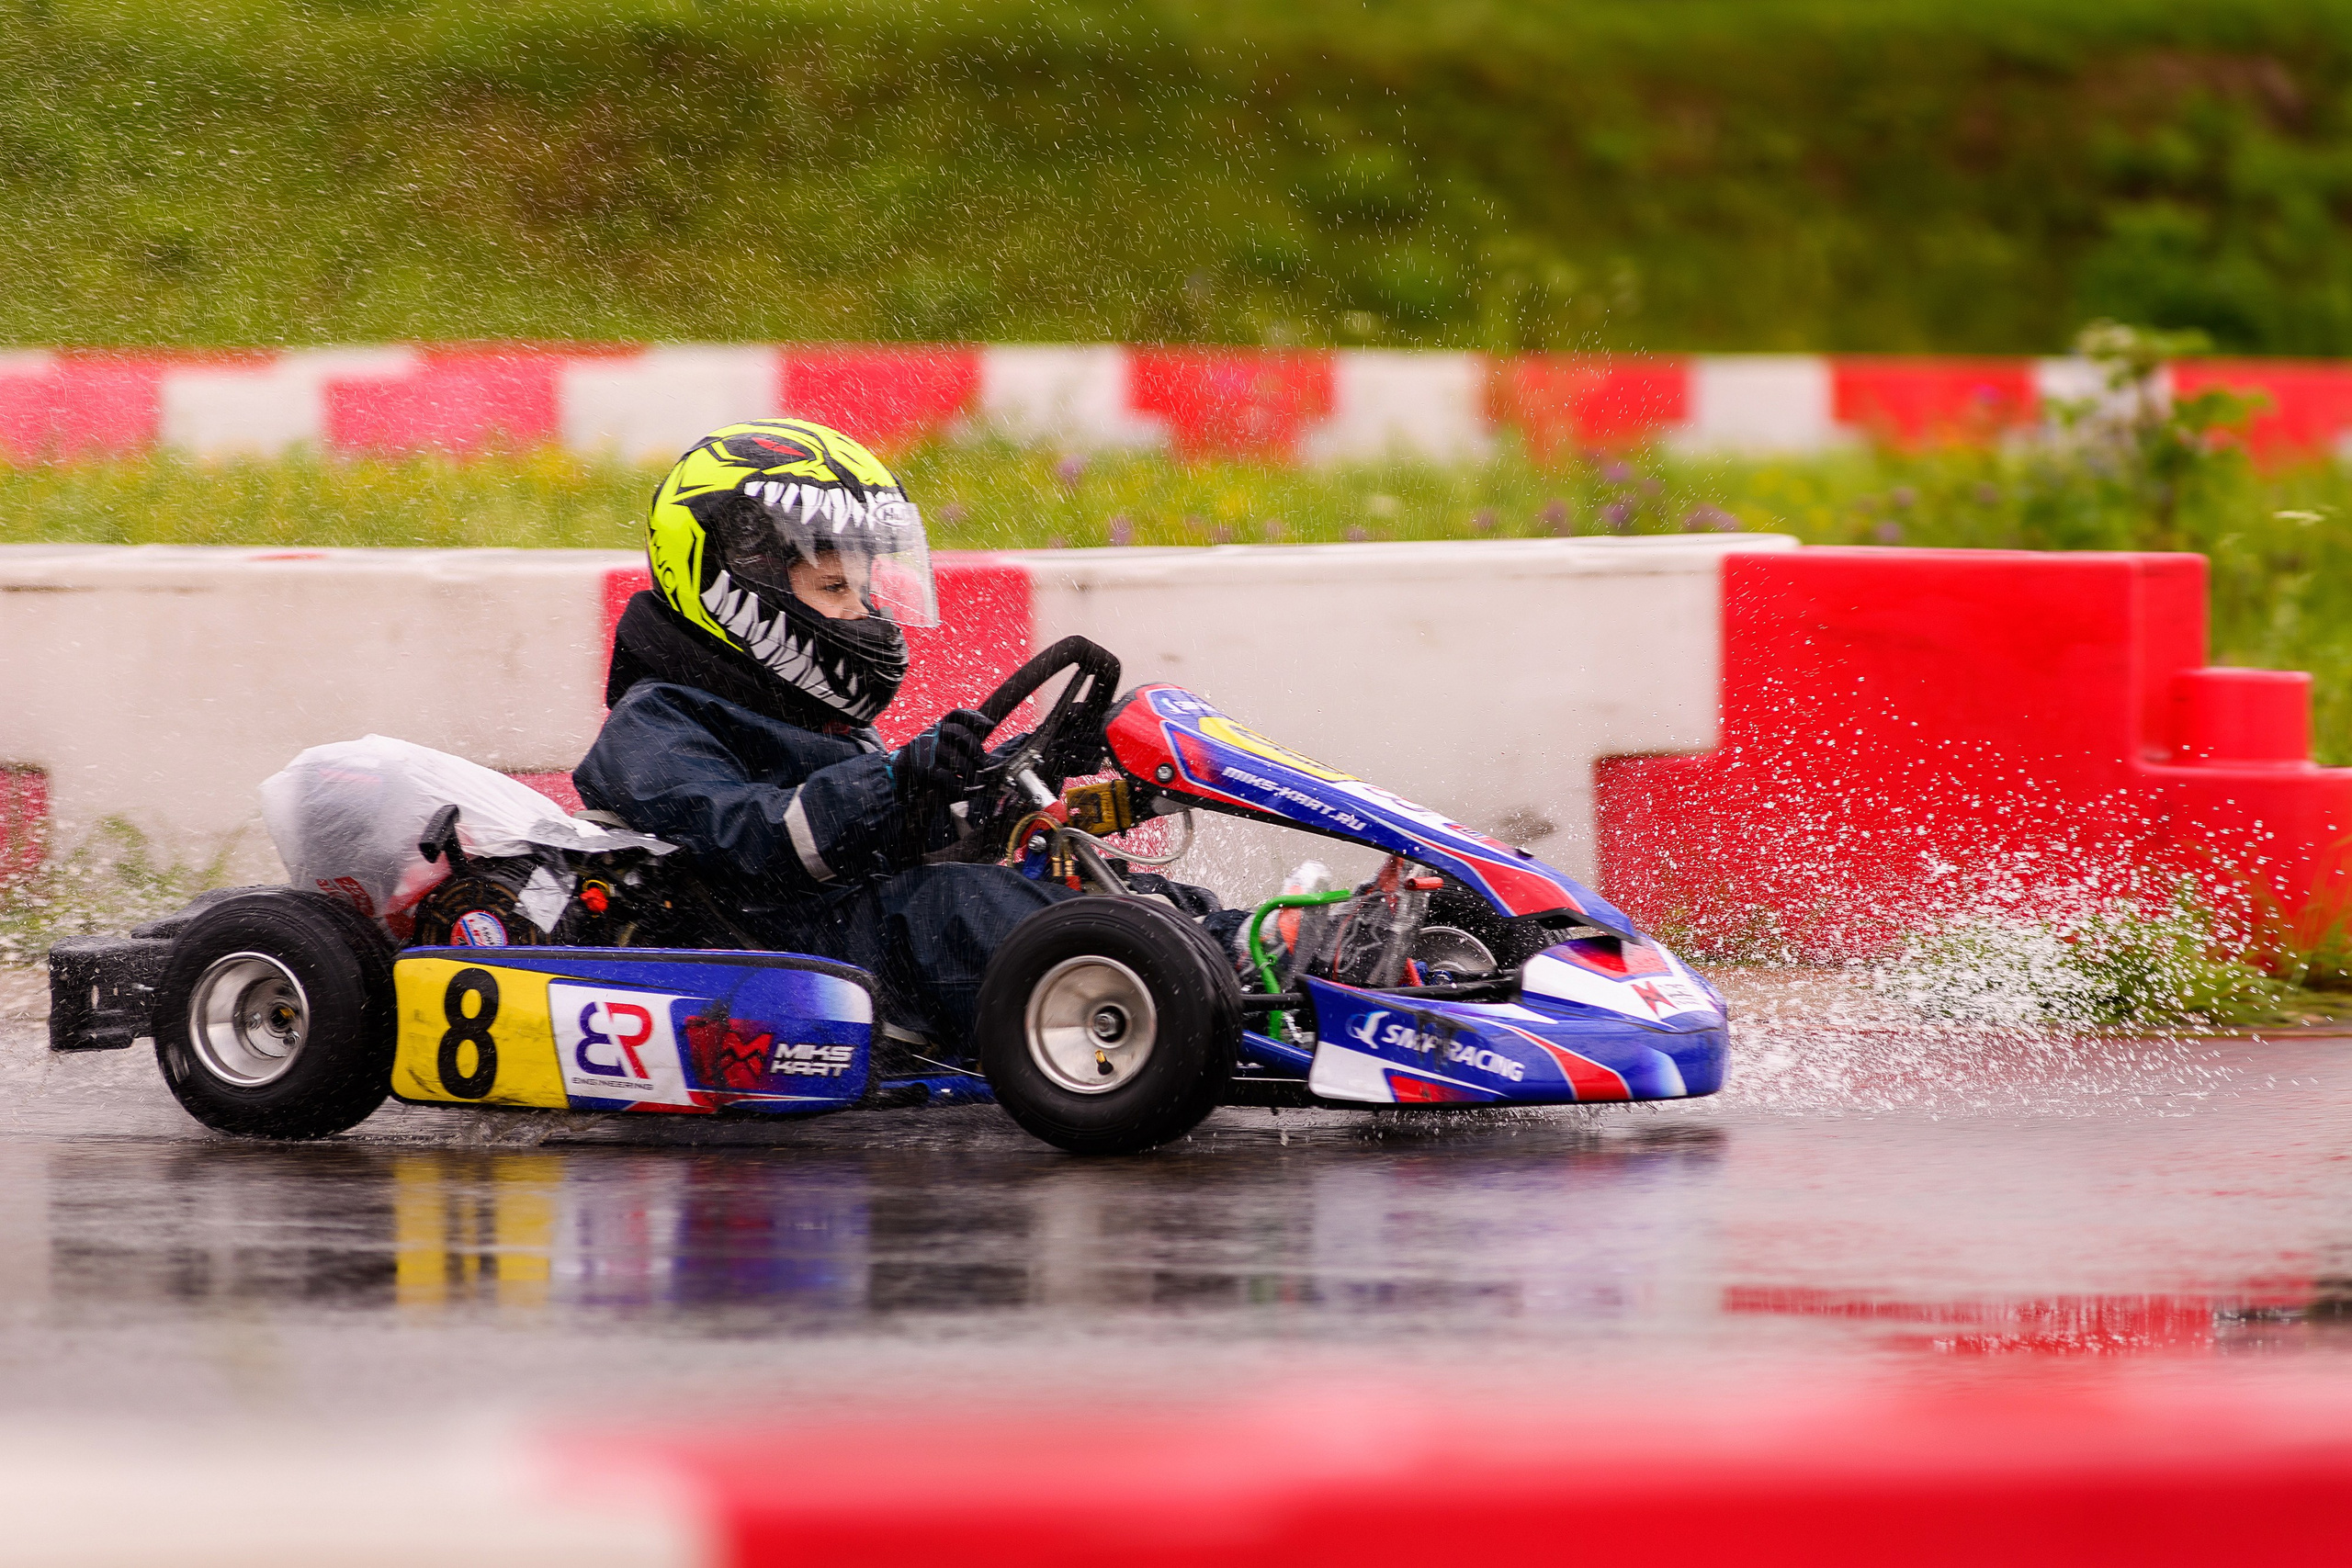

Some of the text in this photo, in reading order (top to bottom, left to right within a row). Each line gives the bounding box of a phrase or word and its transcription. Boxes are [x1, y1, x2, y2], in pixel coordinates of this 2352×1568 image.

[1221, 766, 1368, 831] MIKS-KART.RU
[437, 968, 499, 1100] 8
[775, 1043, 855, 1062] MIKS
[1445, 1041, 1526, 1082] RACING
[571, 1077, 654, 1090] ENGINEERING
[770, 1060, 851, 1077] KART
